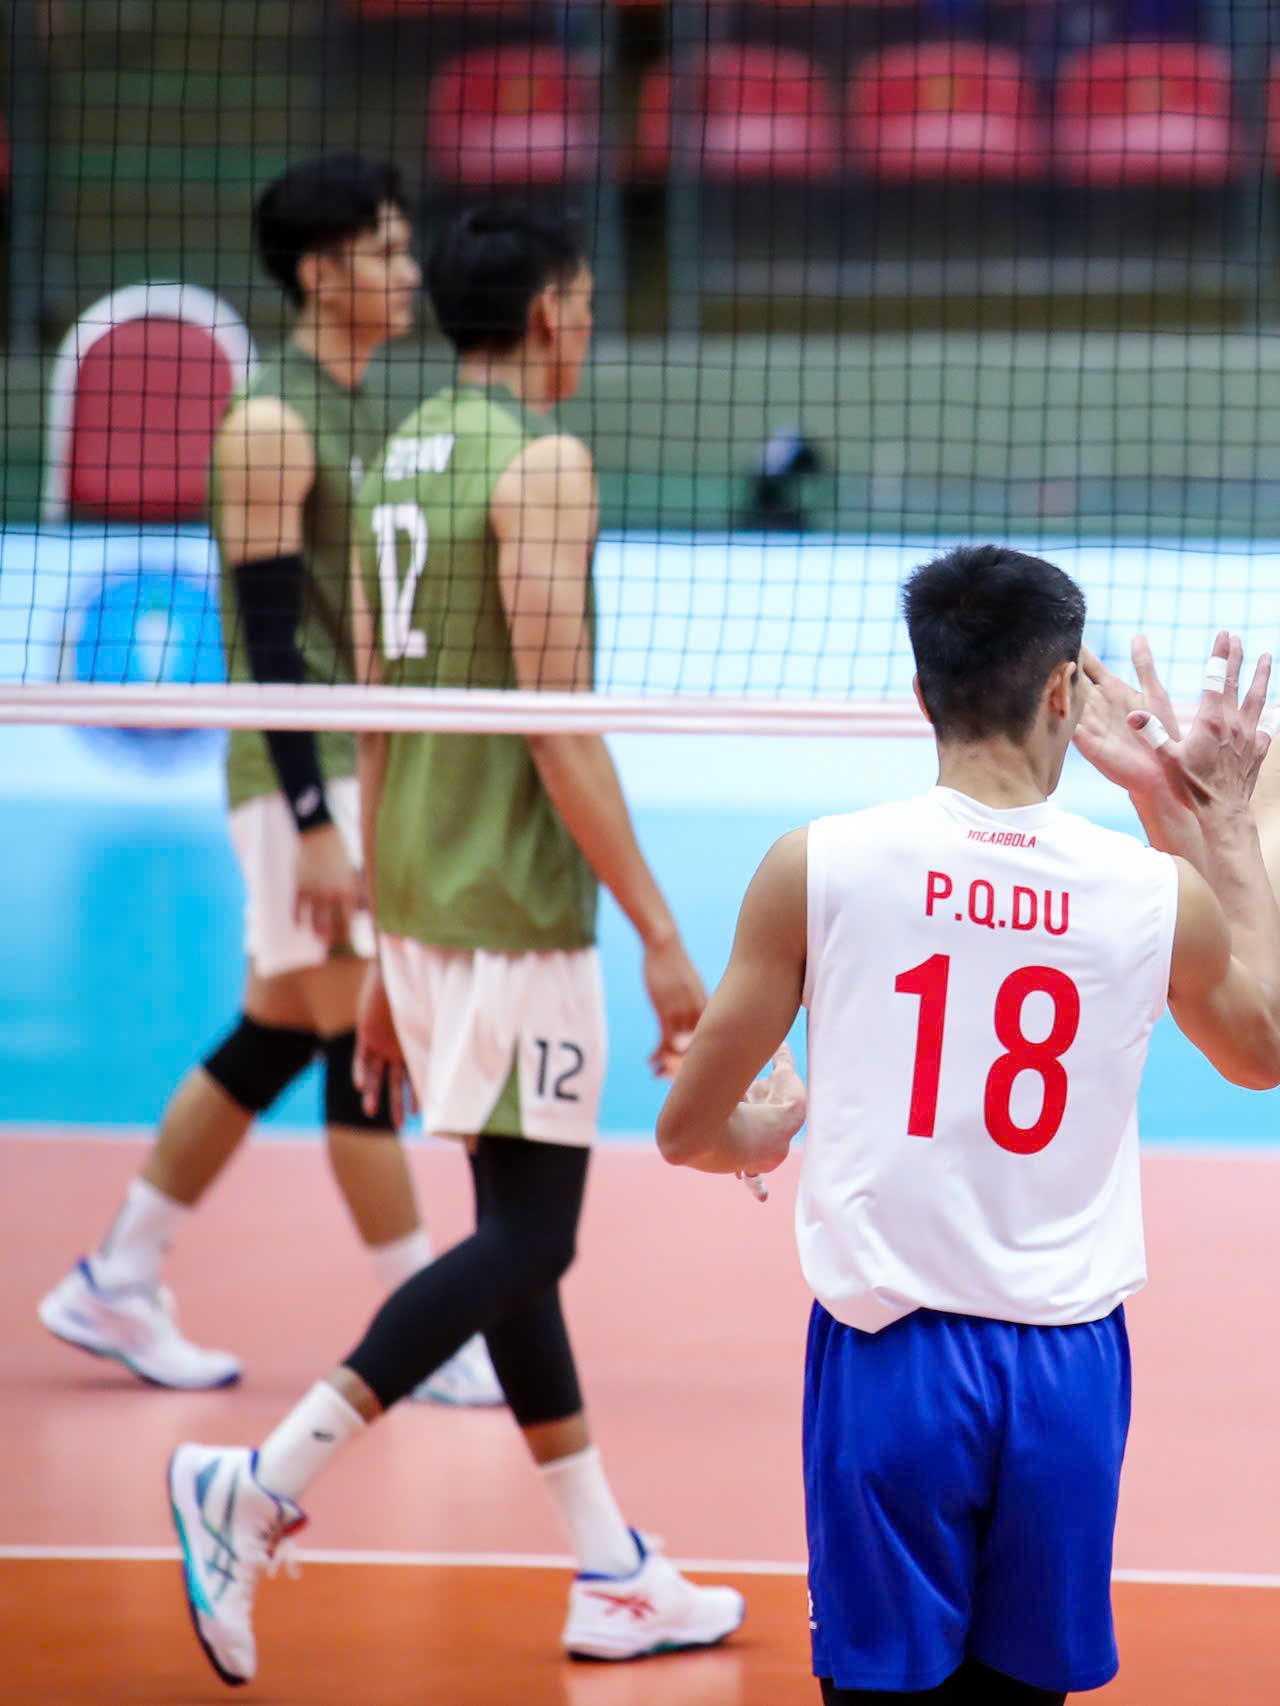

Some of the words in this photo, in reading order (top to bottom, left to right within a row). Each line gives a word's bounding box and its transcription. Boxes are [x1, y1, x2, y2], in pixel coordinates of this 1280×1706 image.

[925, 871, 1069, 935] P.Q.DU
[535, 1038, 584, 1101] 12
[894, 953, 1080, 1155] 18
